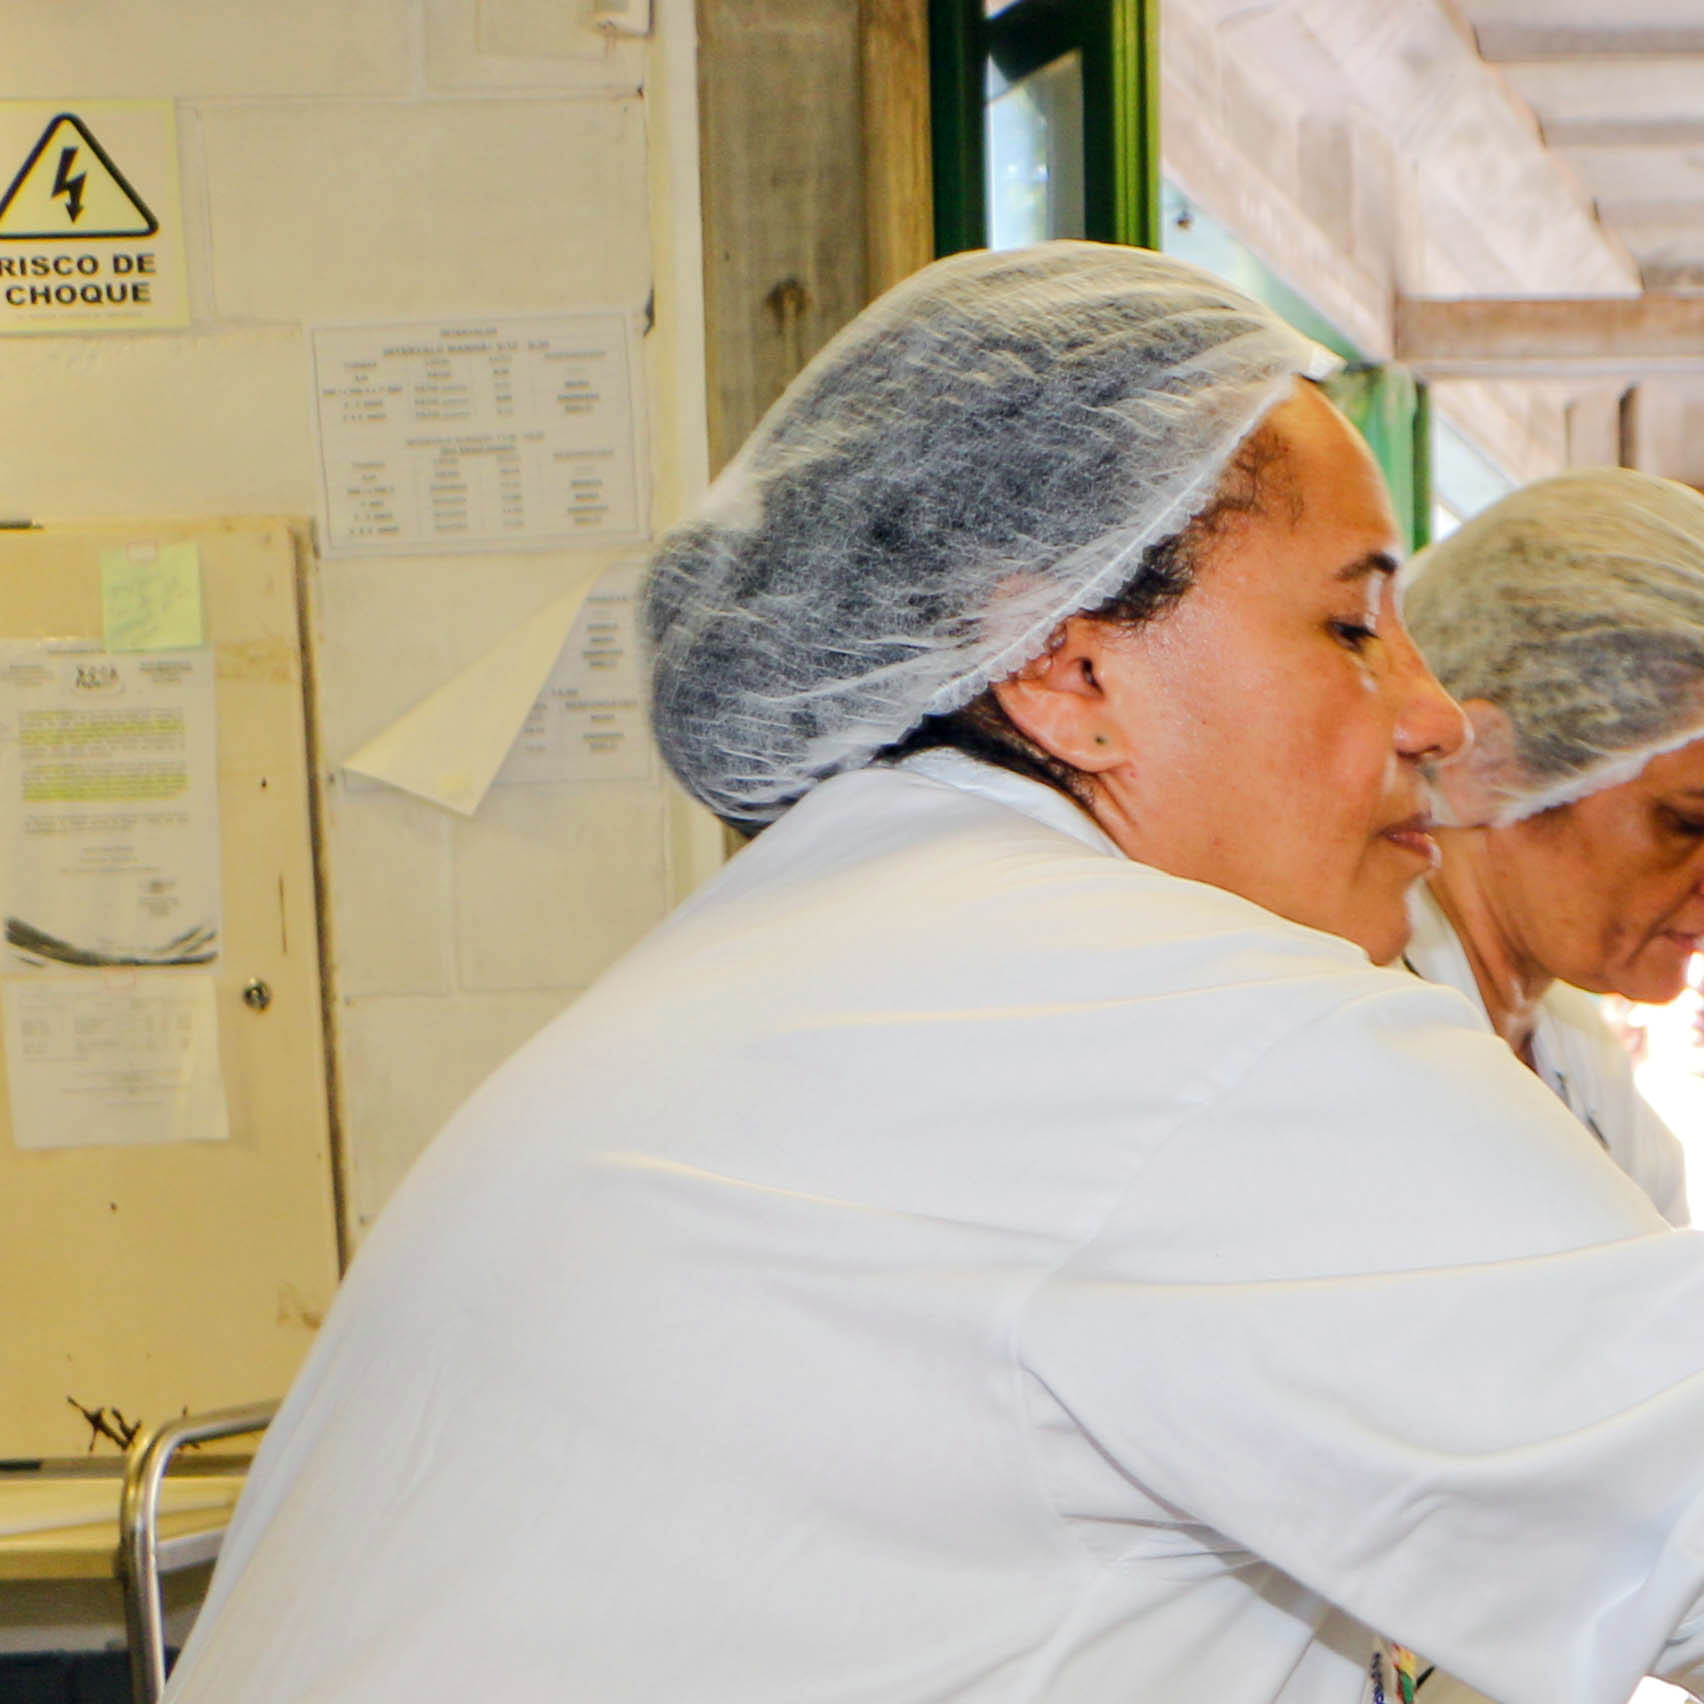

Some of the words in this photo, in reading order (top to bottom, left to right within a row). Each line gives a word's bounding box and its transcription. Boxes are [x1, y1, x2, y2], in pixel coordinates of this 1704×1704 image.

[0, 254, 99, 276] RISCO
[112, 252, 157, 275] DE
[5, 281, 153, 306] CHOQUE
